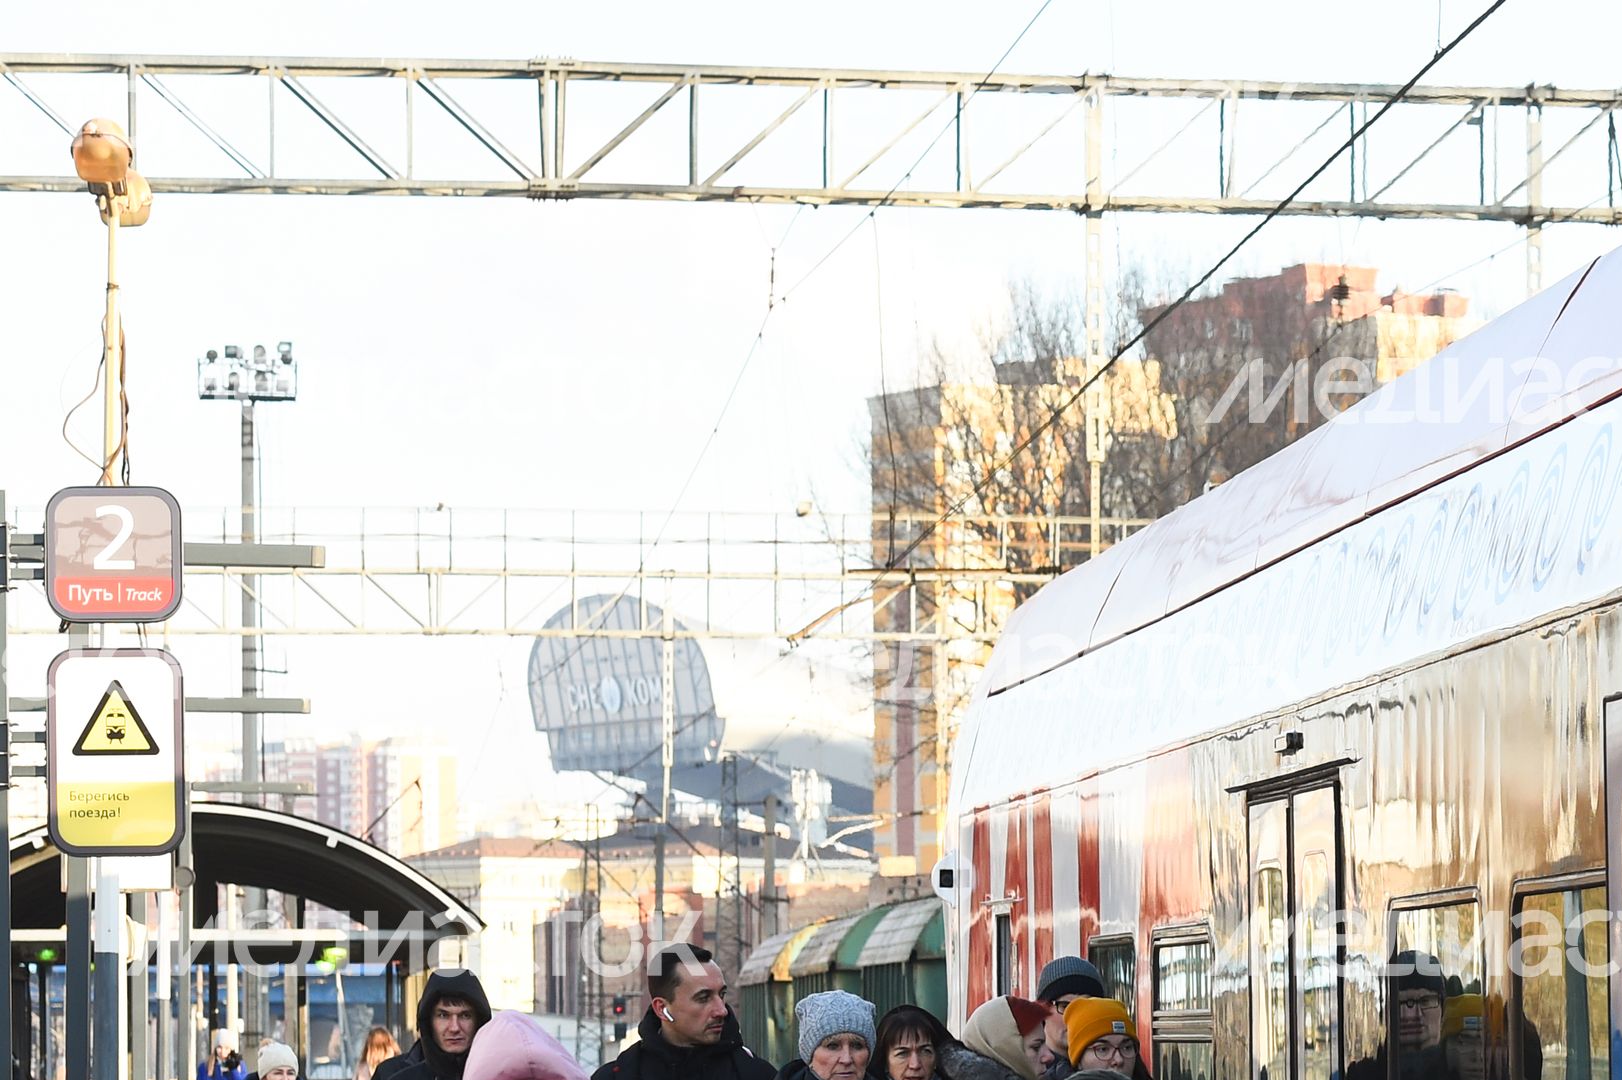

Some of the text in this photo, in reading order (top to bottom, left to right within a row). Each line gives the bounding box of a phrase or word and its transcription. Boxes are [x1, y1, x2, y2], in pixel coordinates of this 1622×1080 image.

[93, 505, 136, 571] 2
[68, 582, 114, 604] Путь
[125, 586, 162, 602] Track
[69, 789, 130, 804] Берегись
[69, 806, 122, 820] поезда!
